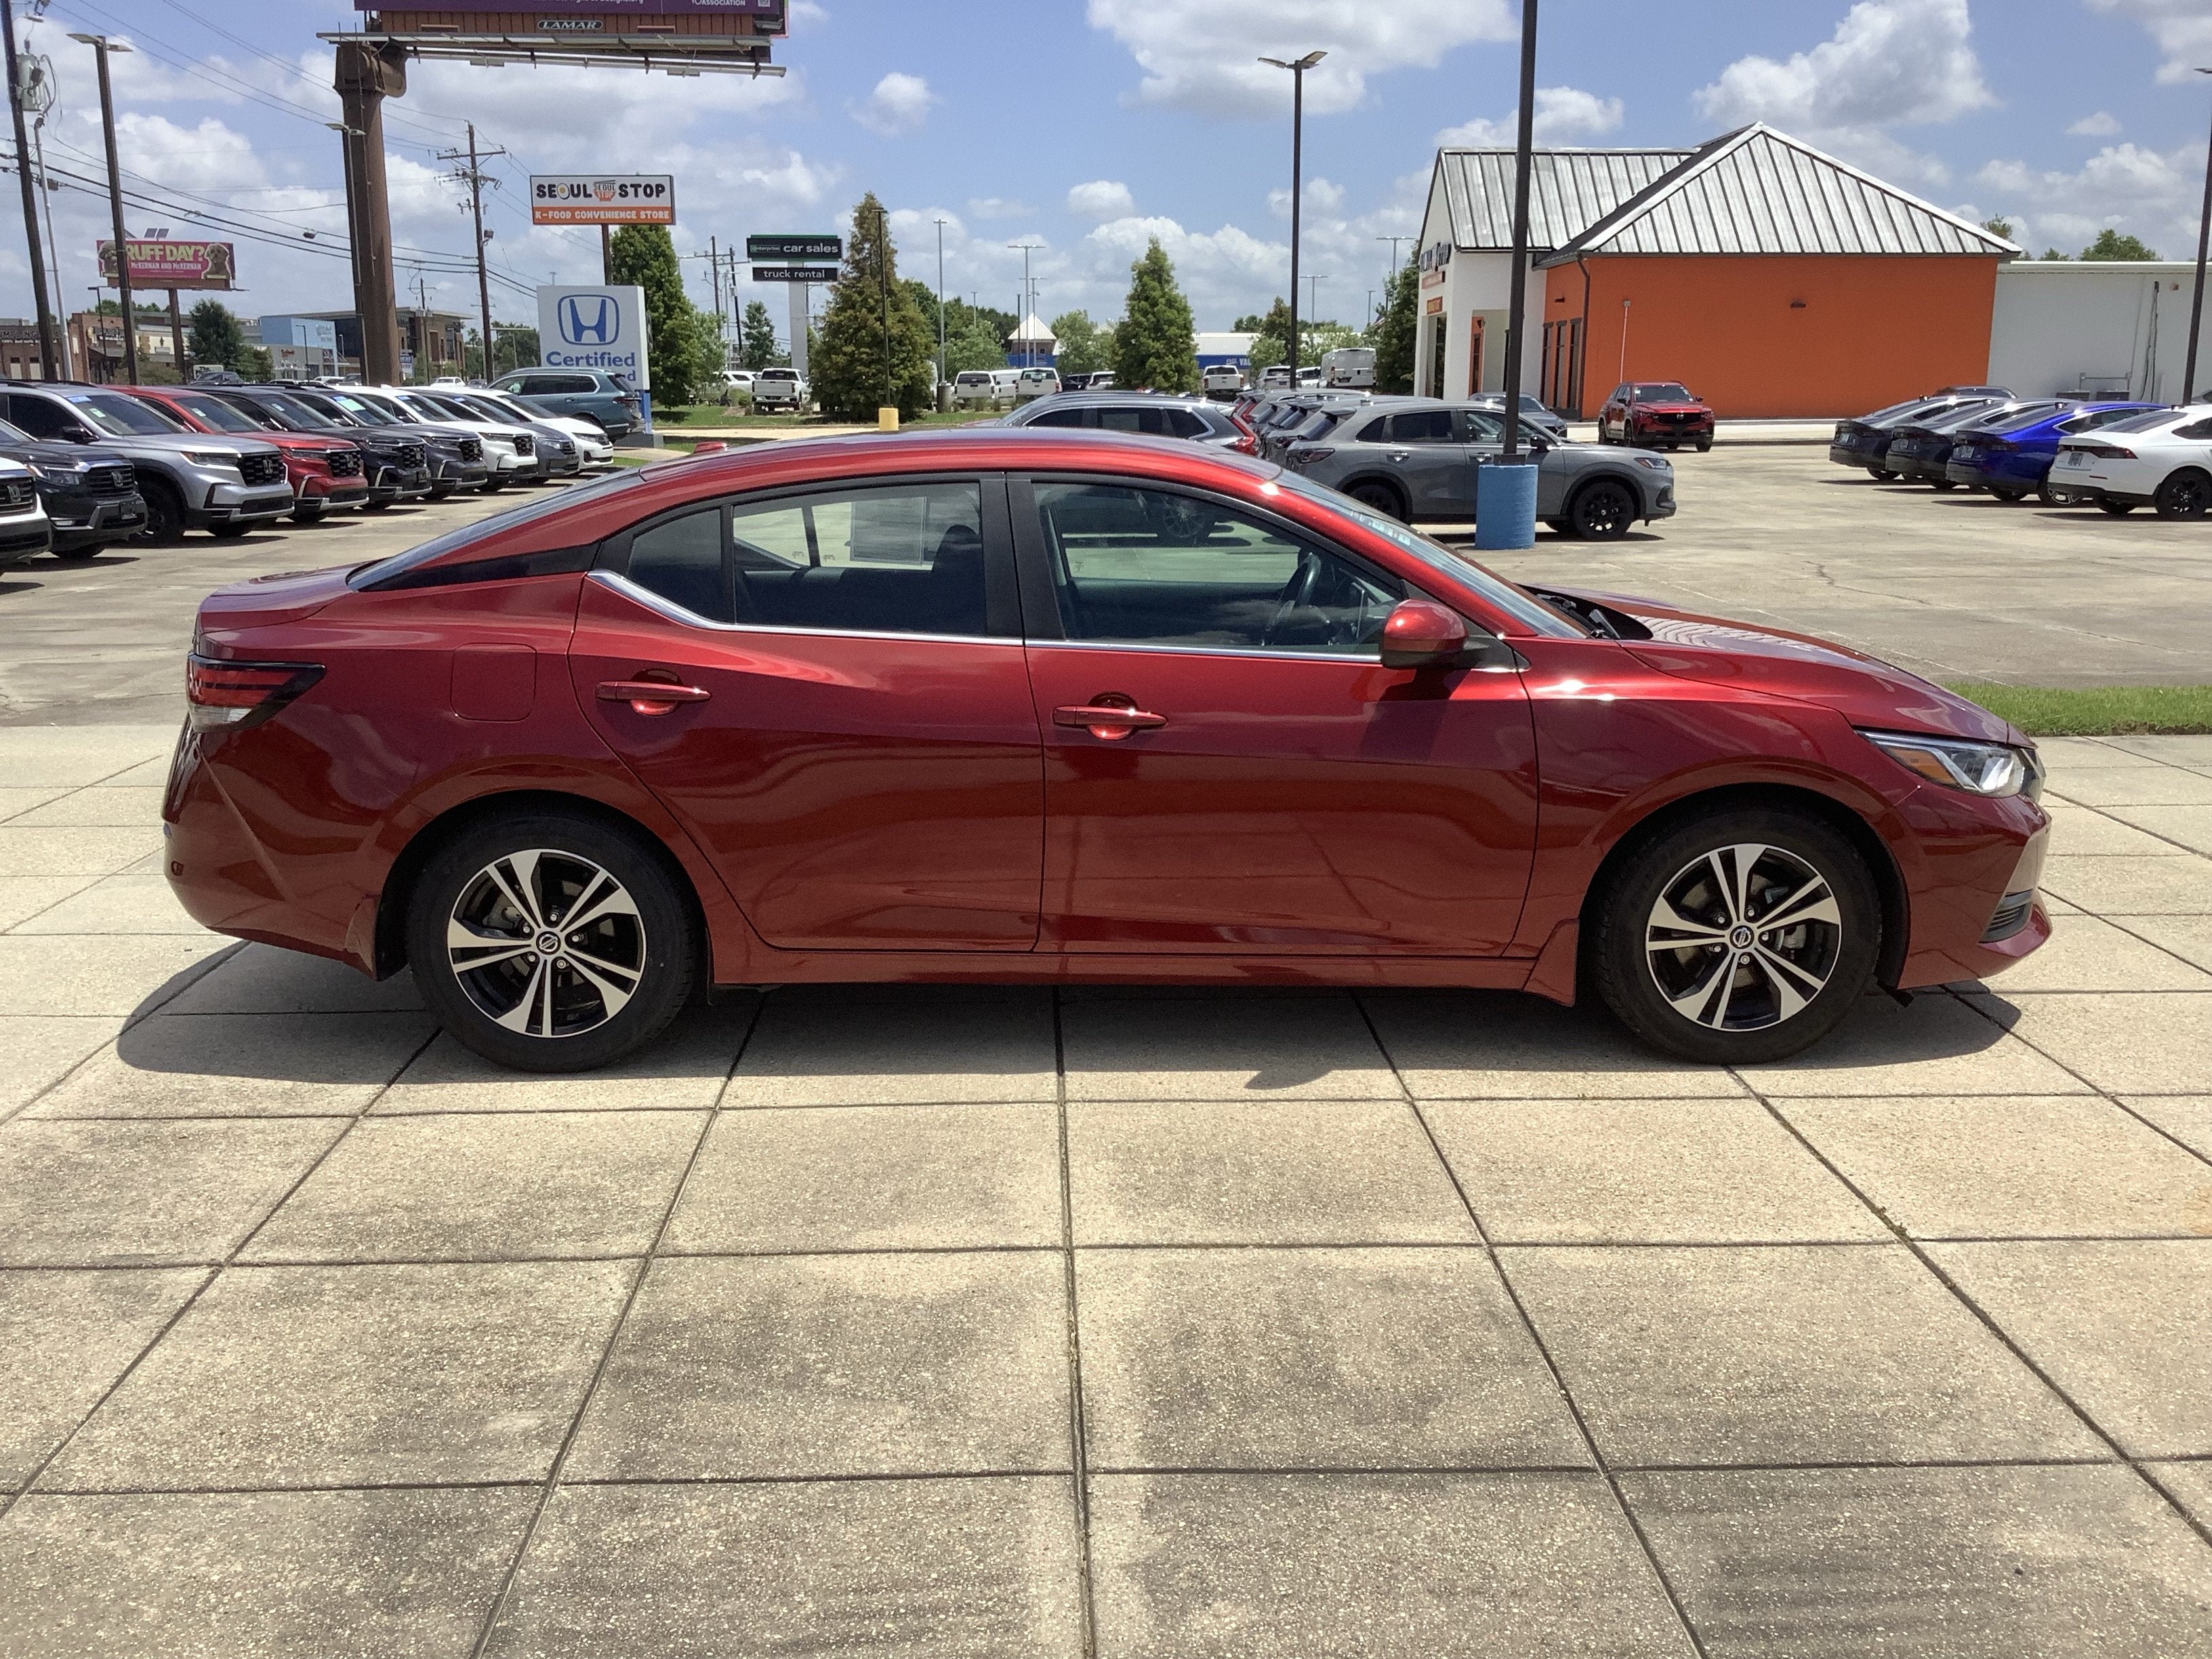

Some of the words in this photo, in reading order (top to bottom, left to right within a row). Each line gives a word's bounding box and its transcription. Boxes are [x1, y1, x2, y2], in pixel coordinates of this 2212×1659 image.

[543, 20, 597, 30] LAMAR
[536, 182, 593, 200] SEOUL
[618, 183, 665, 198] STOP
[575, 211, 637, 220] CONVENIENCE
[640, 210, 670, 219] STORE
[126, 244, 164, 261] RUFF
[165, 245, 205, 262] DAY?
[783, 245, 804, 253] car
[806, 242, 839, 253] sales
[763, 269, 791, 279] truck
[794, 269, 825, 279] rental
[546, 350, 636, 367] Certified
